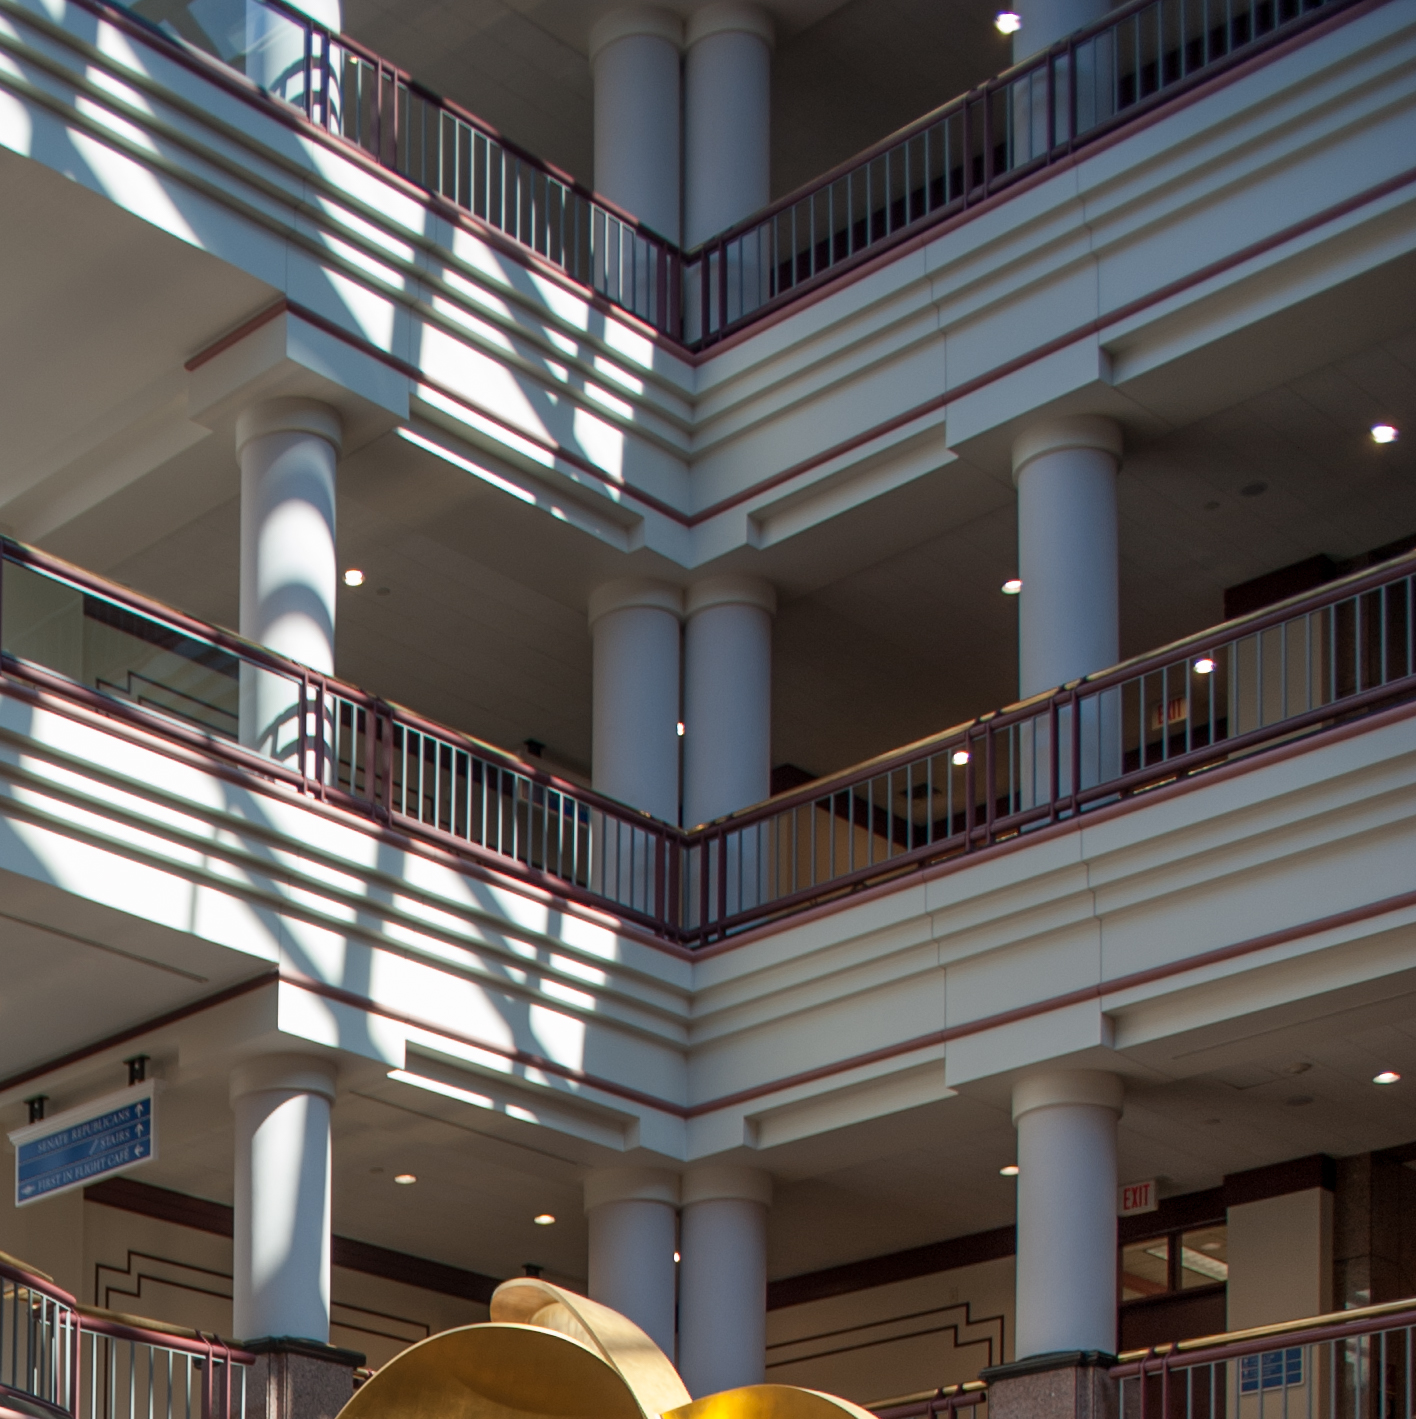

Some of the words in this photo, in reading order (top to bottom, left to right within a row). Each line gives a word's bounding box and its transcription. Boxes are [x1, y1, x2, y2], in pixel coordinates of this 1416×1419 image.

[37, 1133, 69, 1154] SENATE
[71, 1109, 131, 1140] REPUBLICANS
[37, 1174, 61, 1192] FIRST
[63, 1168, 73, 1183] IN
[75, 1158, 106, 1178] FLIGHT
[1123, 1184, 1150, 1210] EXIT
